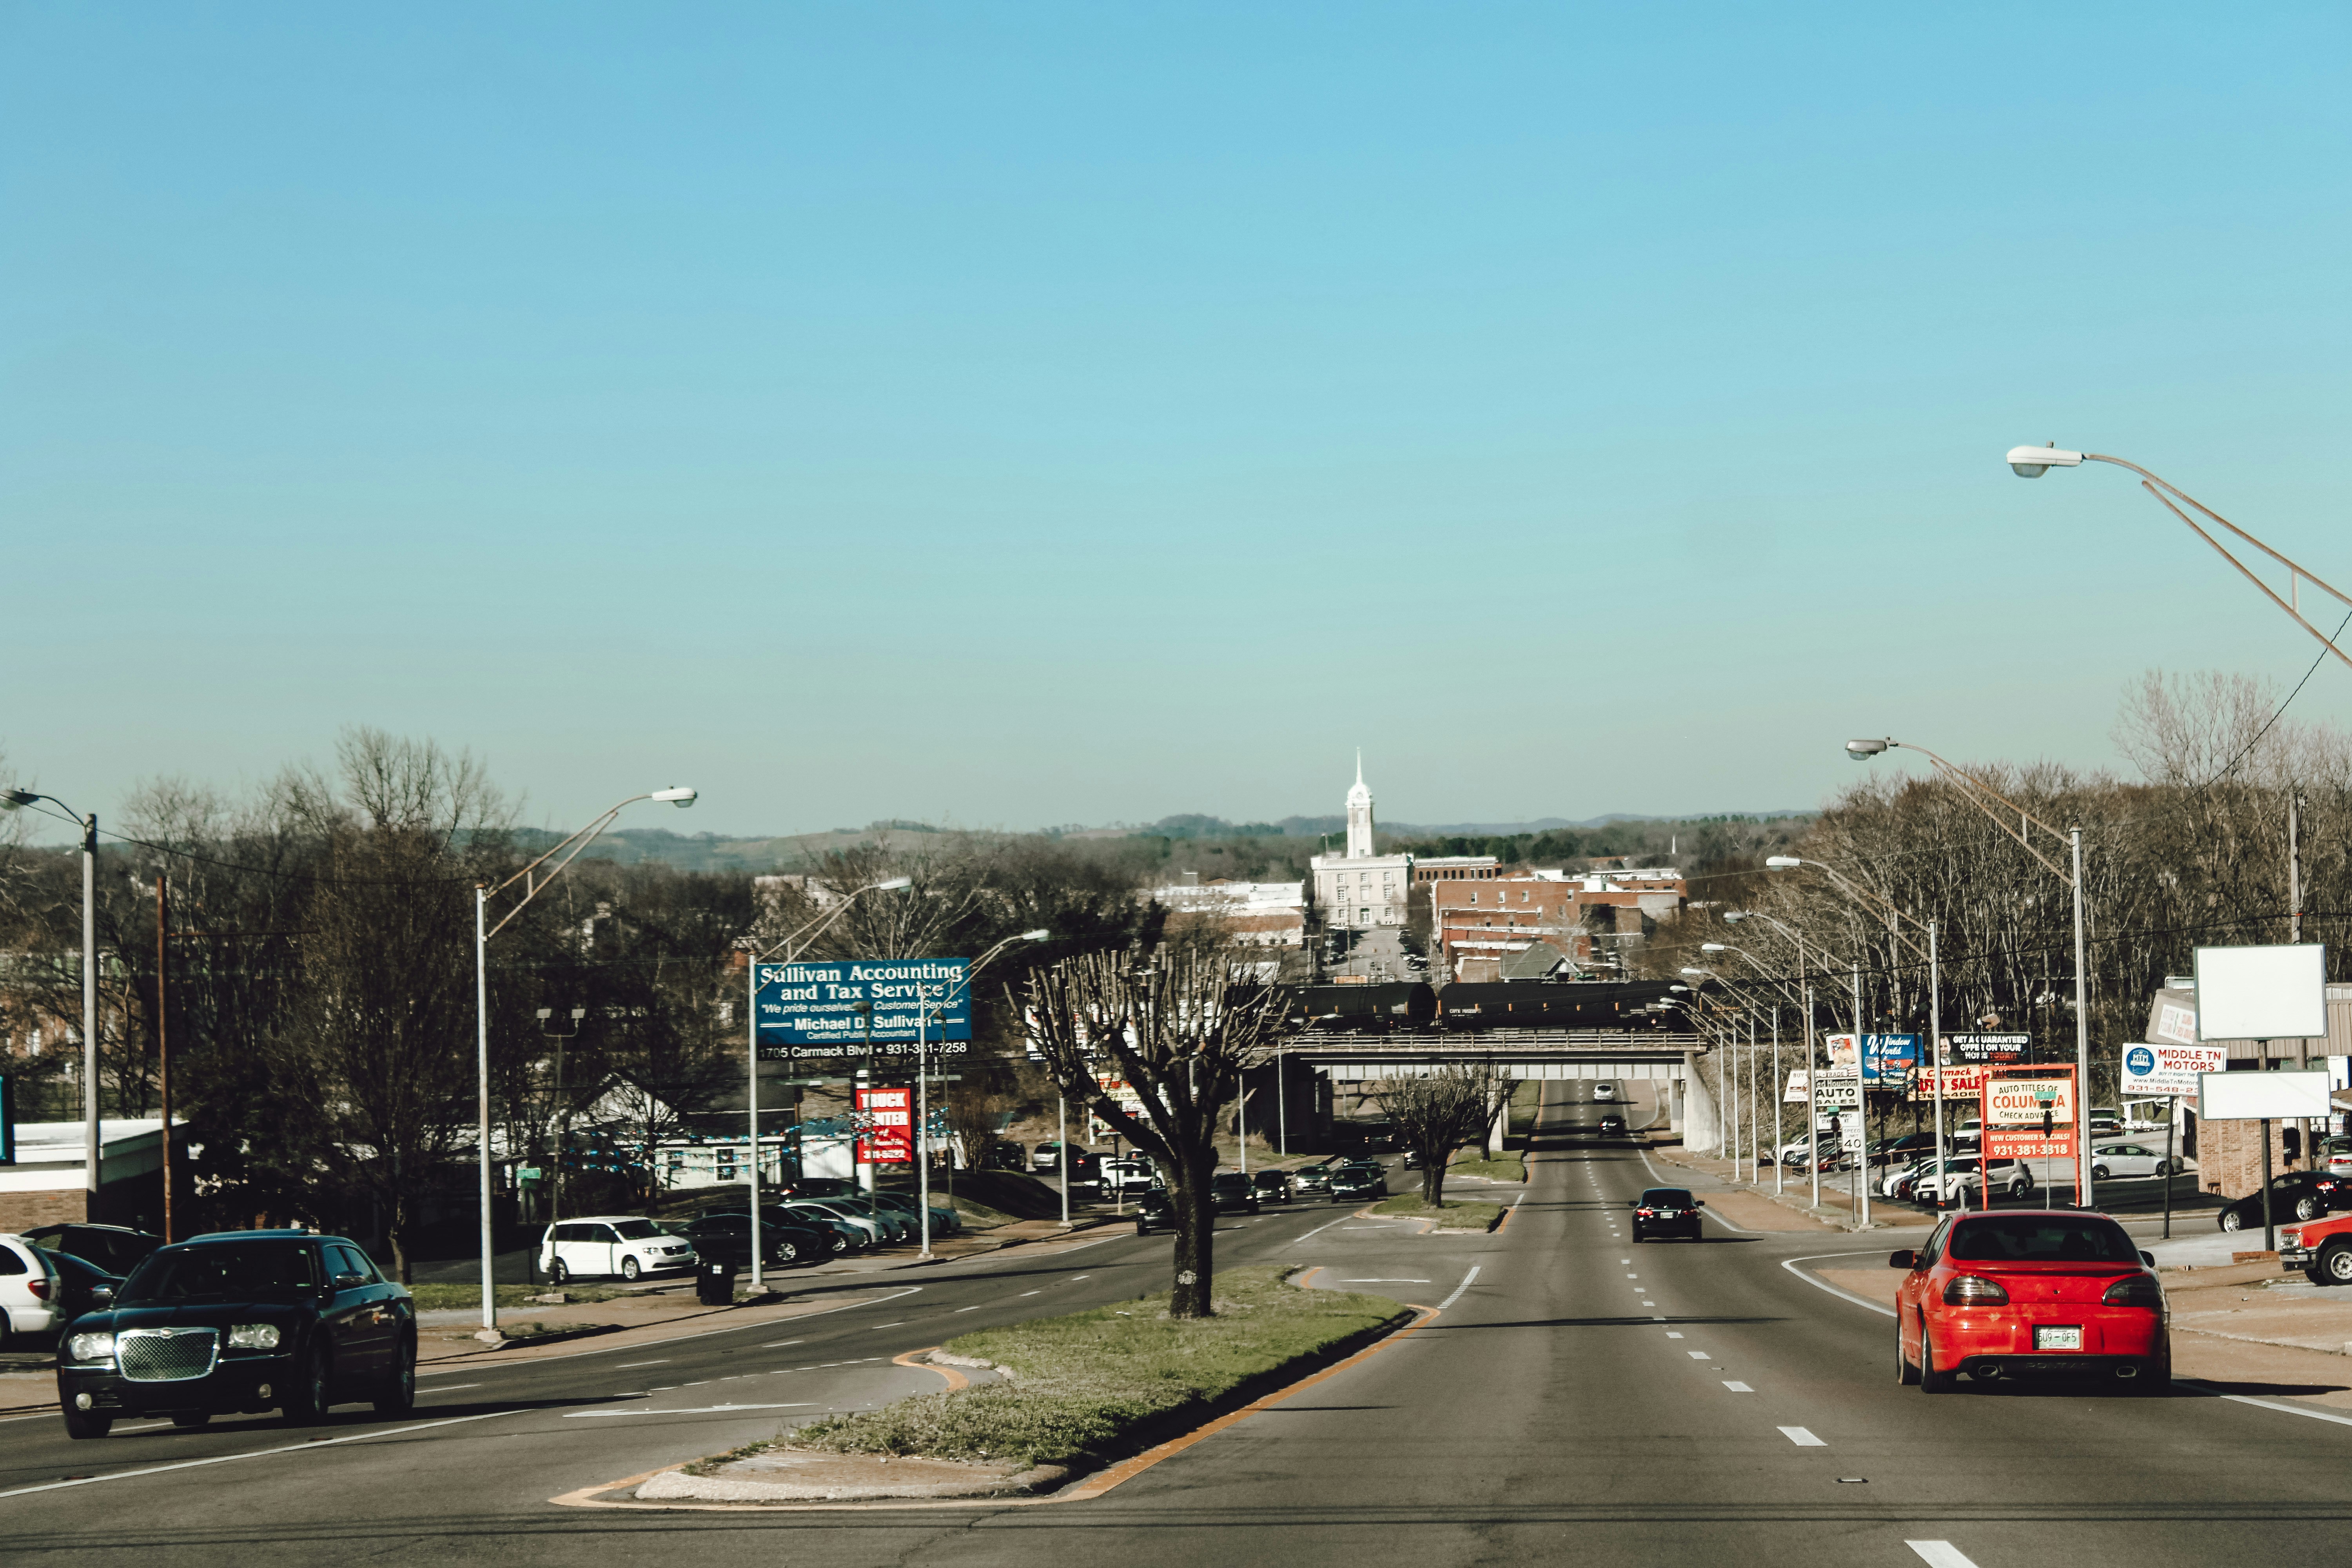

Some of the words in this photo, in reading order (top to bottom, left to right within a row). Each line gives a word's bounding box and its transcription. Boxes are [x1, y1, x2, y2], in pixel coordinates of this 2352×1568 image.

[760, 966, 841, 983] Sullivan
[848, 963, 963, 982] Accounting
[780, 984, 818, 1000] and
[825, 984, 863, 999] Tax
[870, 981, 944, 998] Service
[782, 1004, 808, 1014] pride
[873, 1001, 921, 1010] Customer
[794, 1017, 851, 1030] Michael
[806, 1031, 842, 1040] Certified
[870, 1029, 916, 1038] Accountant
[1953, 1035, 1967, 1044] GET
[1968, 1035, 1975, 1044] A
[1975, 1035, 2028, 1044] GUARANTEED
[760, 1048, 789, 1058] 1705
[791, 1046, 844, 1057] Carmack
[886, 1042, 967, 1054] 931-31-7258
[2158, 1049, 2202, 1059] MIDDLE
[2206, 1051, 2221, 1060] TN
[2133, 1054, 2149, 1062] MTM
[2164, 1061, 2215, 1071] MOTORS
[1927, 1068, 1972, 1077] Crmack
[1816, 1089, 1855, 1098] AUTO
[1999, 1085, 2019, 1094] AUTO
[860, 1093, 906, 1108] TRUCK
[1999, 1111, 2023, 1119] CHECK
[2024, 1110, 2059, 1119] ADVACE
[1844, 1139, 1861, 1148] 40
[1993, 1144, 2068, 1156] 931-381-3818
